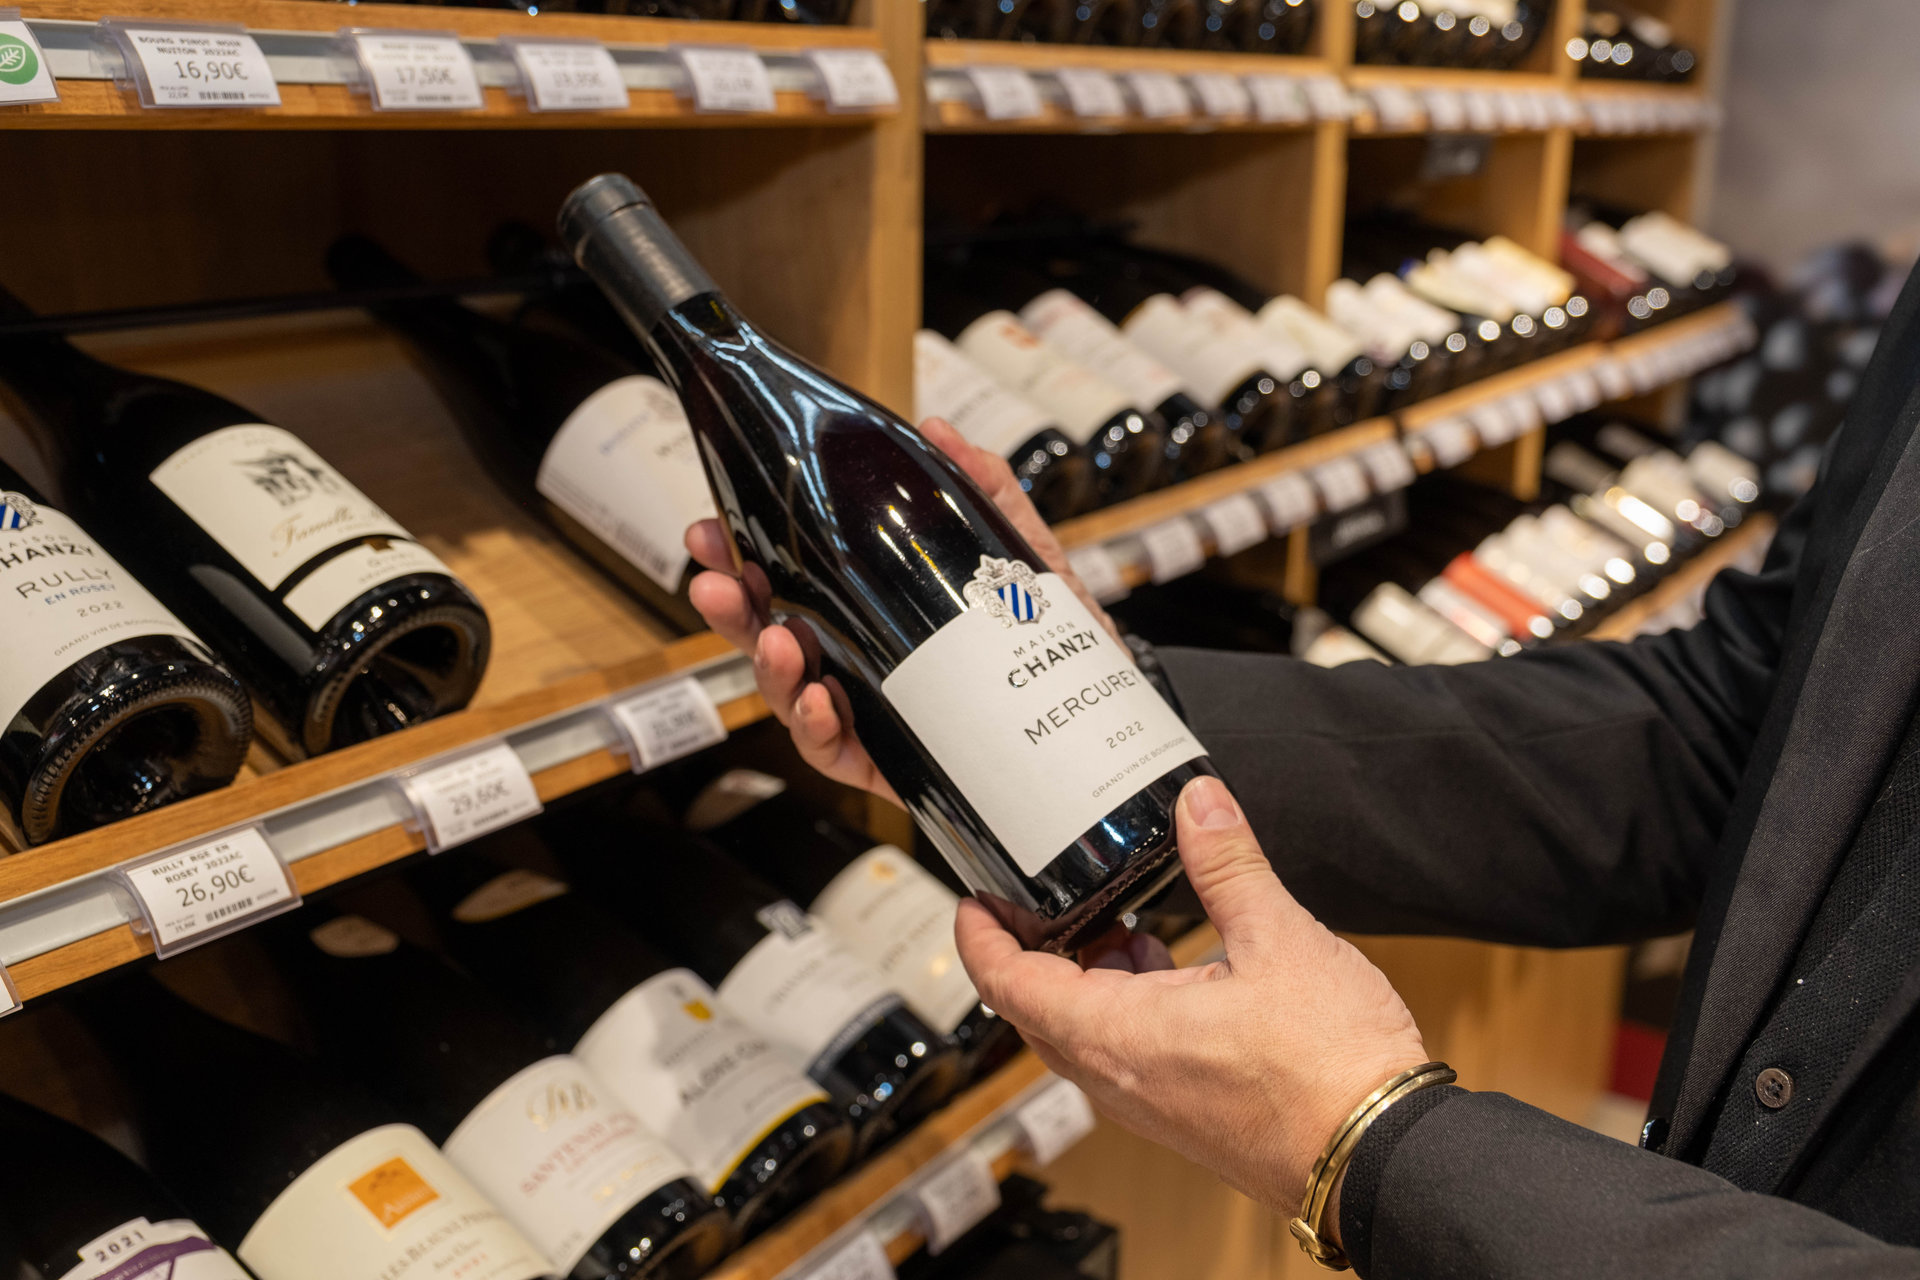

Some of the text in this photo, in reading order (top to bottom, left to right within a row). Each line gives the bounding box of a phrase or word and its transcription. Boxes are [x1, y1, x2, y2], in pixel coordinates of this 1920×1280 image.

[174, 60, 249, 83] 16,90€
[0, 534, 69, 552] AISON
[0, 543, 95, 573] HANZY
[16, 567, 112, 599] RULLY
[44, 592, 66, 606] EN
[76, 600, 125, 618] 2022
[54, 632, 90, 657] GRAND
[91, 625, 109, 636] VIN
[1013, 621, 1076, 658] MAISON
[1007, 630, 1100, 689] CHANZY
[1023, 668, 1141, 746] MERCUREY
[1105, 720, 1145, 749] 2022
[1091, 772, 1125, 799] GRAND
[1124, 761, 1140, 775] VIN
[1139, 751, 1151, 766] DE
[151, 844, 230, 877] RULLY RGE EN
[165, 866, 199, 884] ROSEY
[176, 864, 256, 908] 26,90€
[94, 1228, 146, 1263] 2021
